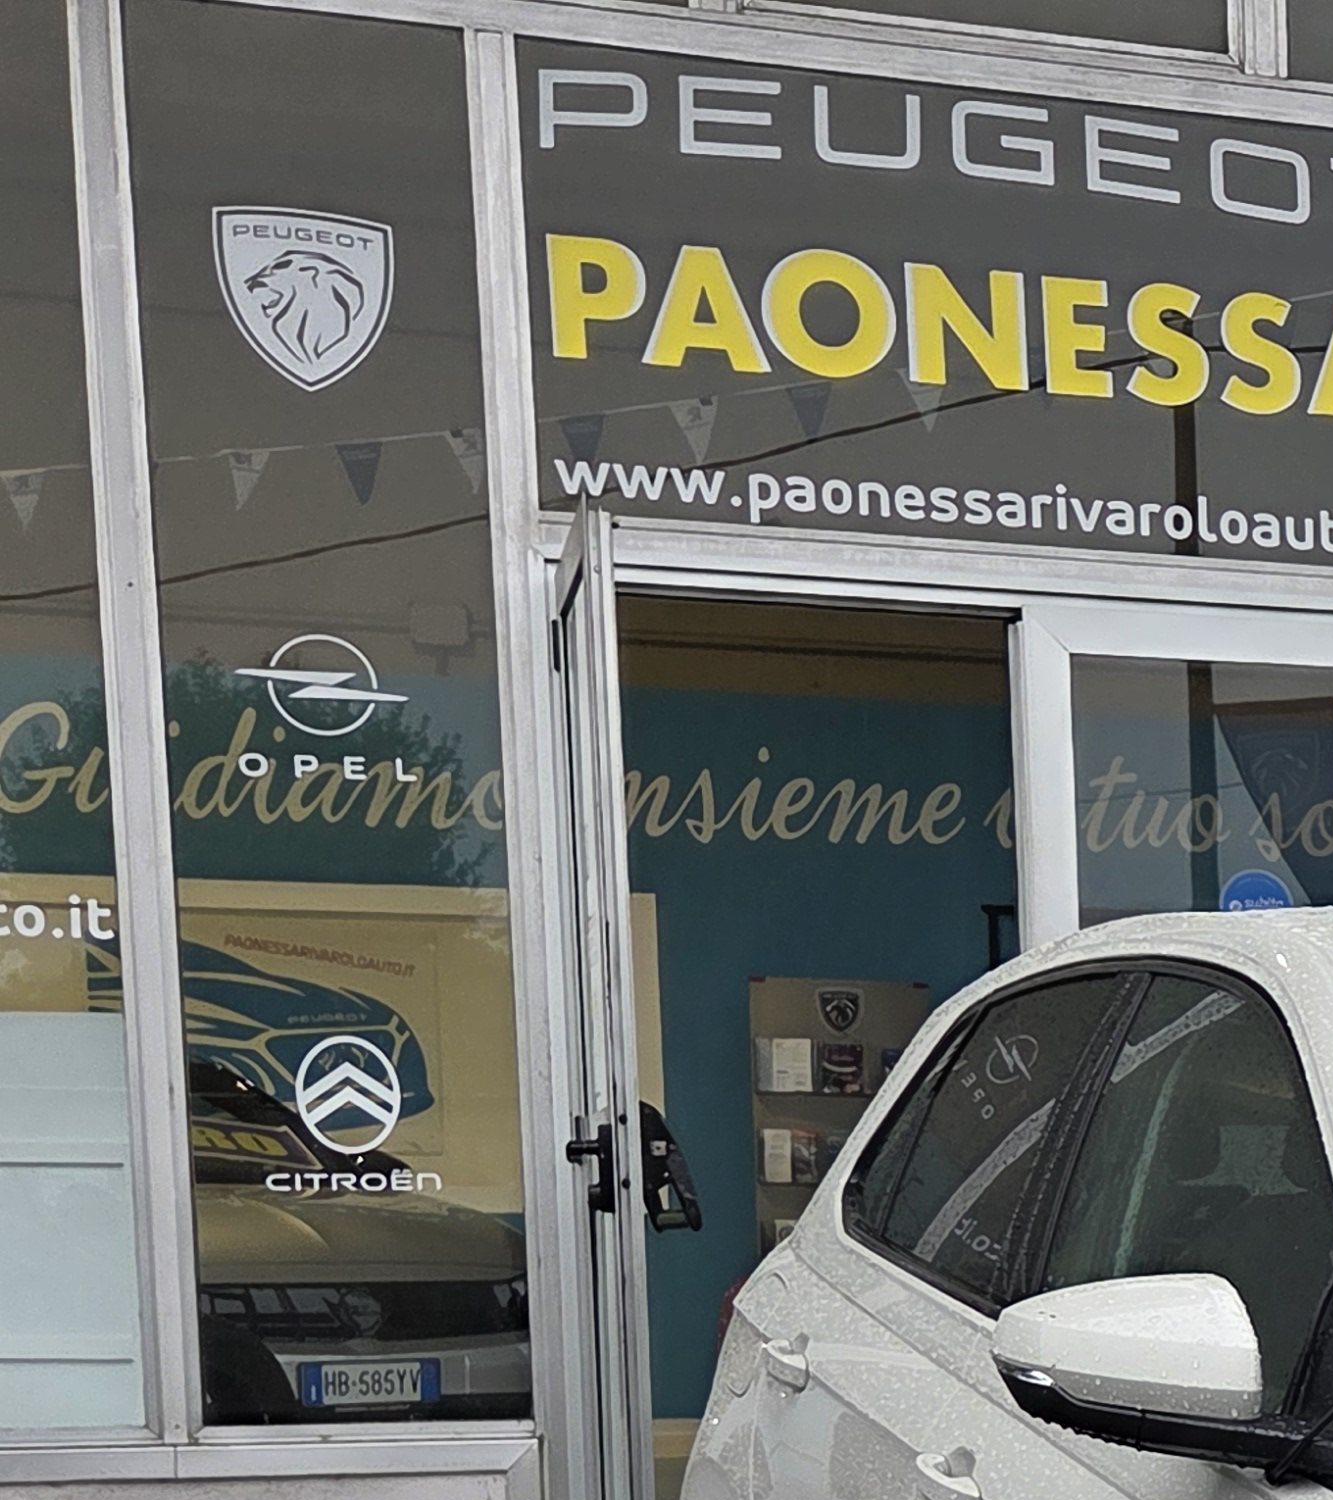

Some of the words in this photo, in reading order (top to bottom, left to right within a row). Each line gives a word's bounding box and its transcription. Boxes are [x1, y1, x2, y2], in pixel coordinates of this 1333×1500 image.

[231, 223, 376, 251] PEUGEOT
[238, 752, 417, 782] OPEL
[624, 746, 966, 845] nsieme
[1080, 755, 1230, 853] tuo
[265, 1168, 443, 1193] CITROËN
